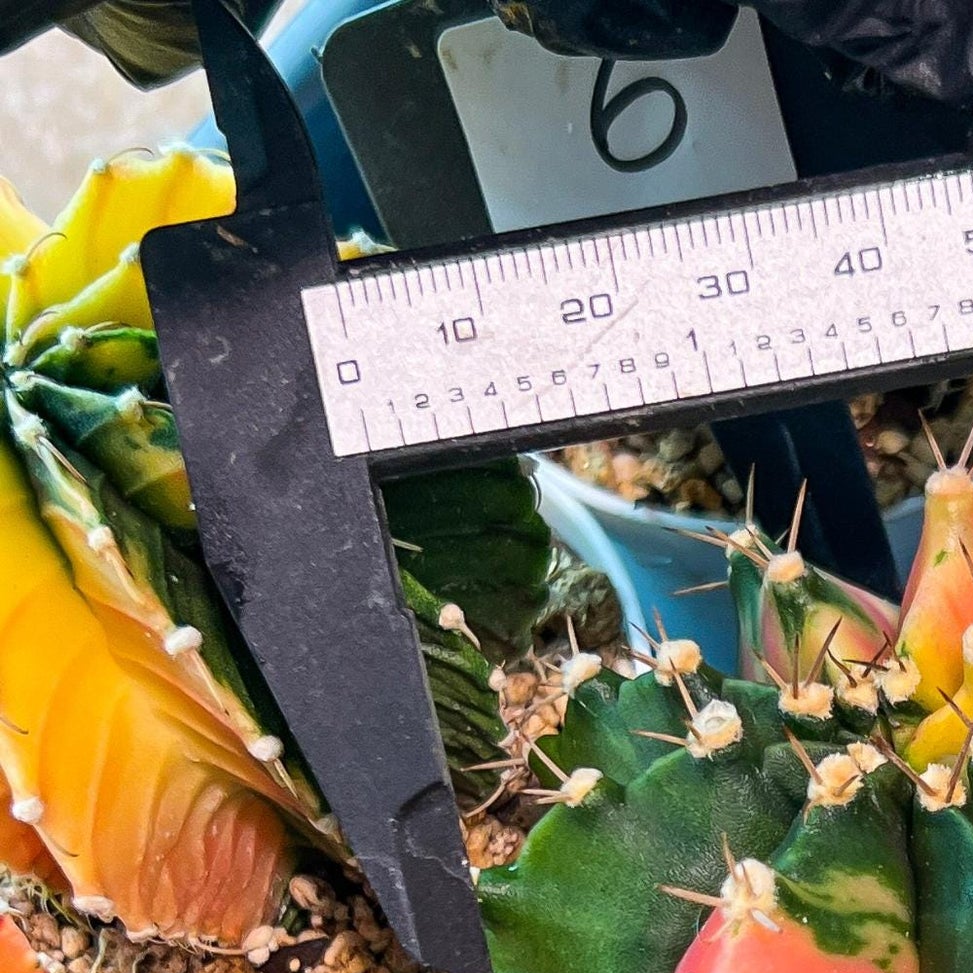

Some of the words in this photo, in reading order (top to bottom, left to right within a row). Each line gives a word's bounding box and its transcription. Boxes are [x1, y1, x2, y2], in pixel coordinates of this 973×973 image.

[589, 57, 688, 173] 6
[336, 360, 361, 385] 0
[437, 317, 478, 345] 10
[560, 293, 614, 324] 20
[697, 270, 751, 299] 30
[834, 246, 883, 276] 40
[387, 400, 396, 414] 1
[414, 393, 430, 409] 2
[449, 387, 465, 402] 3
[484, 381, 498, 396] 4
[517, 375, 532, 391] 5
[551, 369, 567, 385] 6
[588, 363, 600, 379] 7
[619, 357, 636, 374] 8
[654, 352, 670, 369] 9
[686, 328, 698, 351] 1
[729, 340, 738, 356] 1
[756, 335, 772, 350] 2
[790, 328, 806, 344] 3
[825, 323, 839, 337] 4
[857, 316, 873, 333] 5
[891, 311, 907, 327] 6
[927, 305, 940, 320] 7
